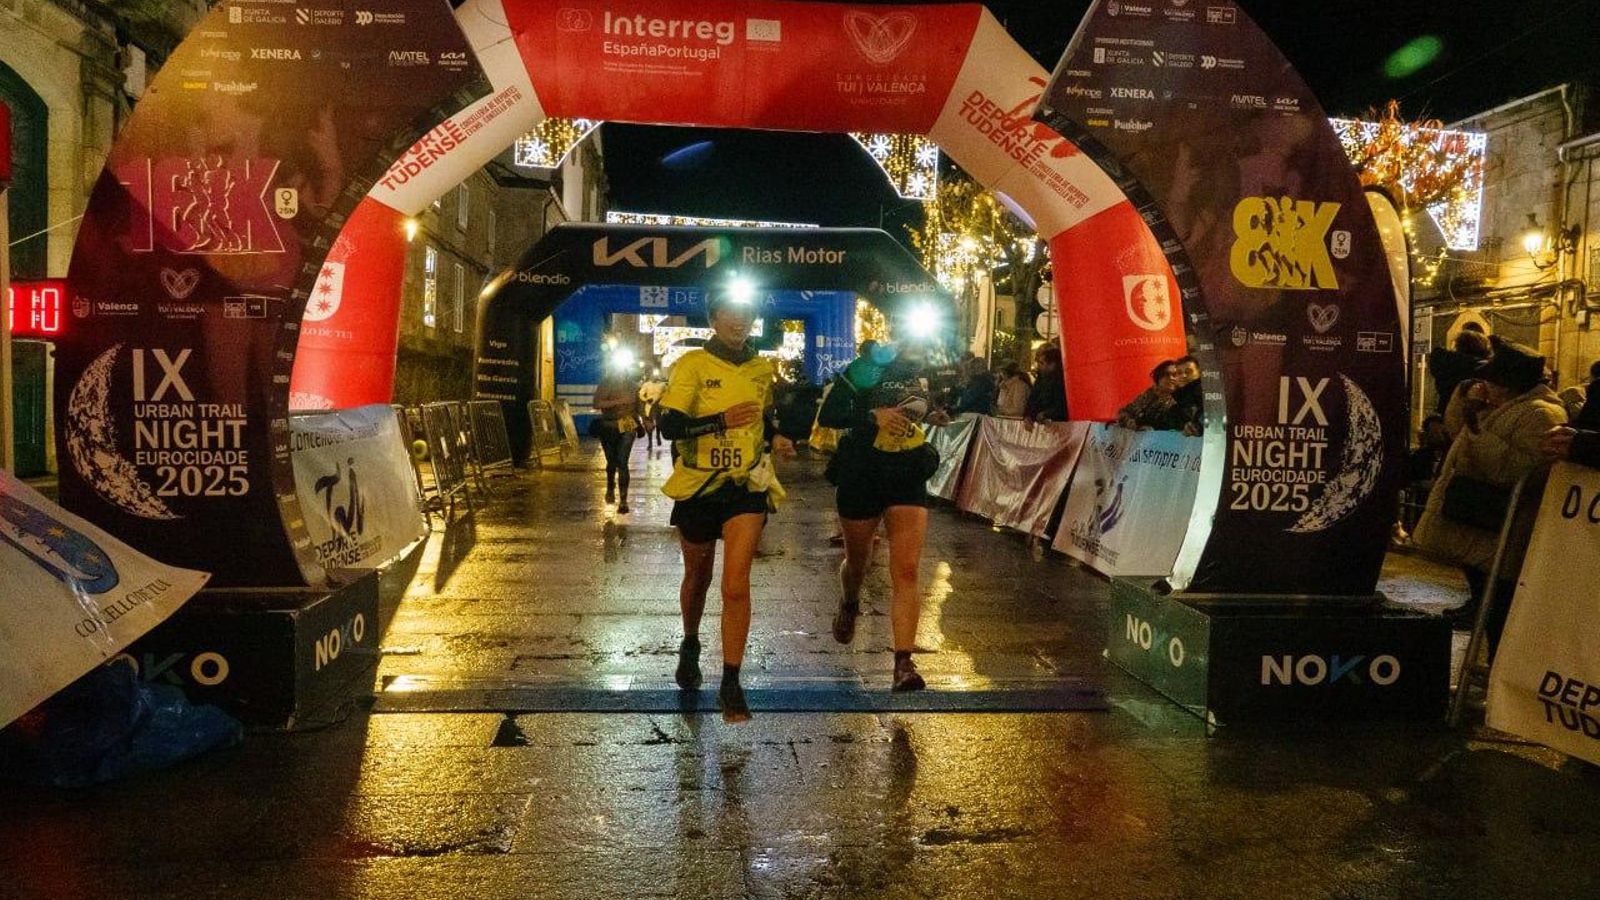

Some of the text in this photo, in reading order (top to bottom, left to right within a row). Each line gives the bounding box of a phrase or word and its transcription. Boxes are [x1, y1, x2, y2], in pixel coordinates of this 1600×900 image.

[603, 11, 735, 44] Interreg
[250, 48, 302, 60] XENERA
[388, 51, 430, 61] AVATEL
[603, 41, 721, 62] EspañaPortugal
[836, 81, 926, 95] TUI VALENÇA
[1110, 87, 1155, 99] XENERA
[965, 90, 1049, 158] DEPORTE
[957, 101, 1037, 169] TUDENSE
[380, 126, 468, 191] TUDENSE
[742, 247, 782, 264] Rias
[788, 247, 847, 265] Motor
[520, 271, 571, 285] blendio
[886, 282, 936, 294] blendio
[132, 348, 197, 402] IX
[133, 403, 248, 418] URBAN TRAIL
[1278, 375, 1331, 427] IX
[135, 419, 248, 450] NIGHT
[1234, 425, 1329, 442] URBAN TRAIL
[136, 451, 249, 466] EUROCIDADE
[710, 447, 742, 468] 665
[1142, 448, 1180, 469] sempre
[1232, 440, 1329, 469] NIGHT
[156, 466, 250, 497] 2025
[1231, 468, 1328, 484] EUROCIDADE
[1230, 482, 1310, 512] 2025
[1260, 653, 1401, 686] NOKO
